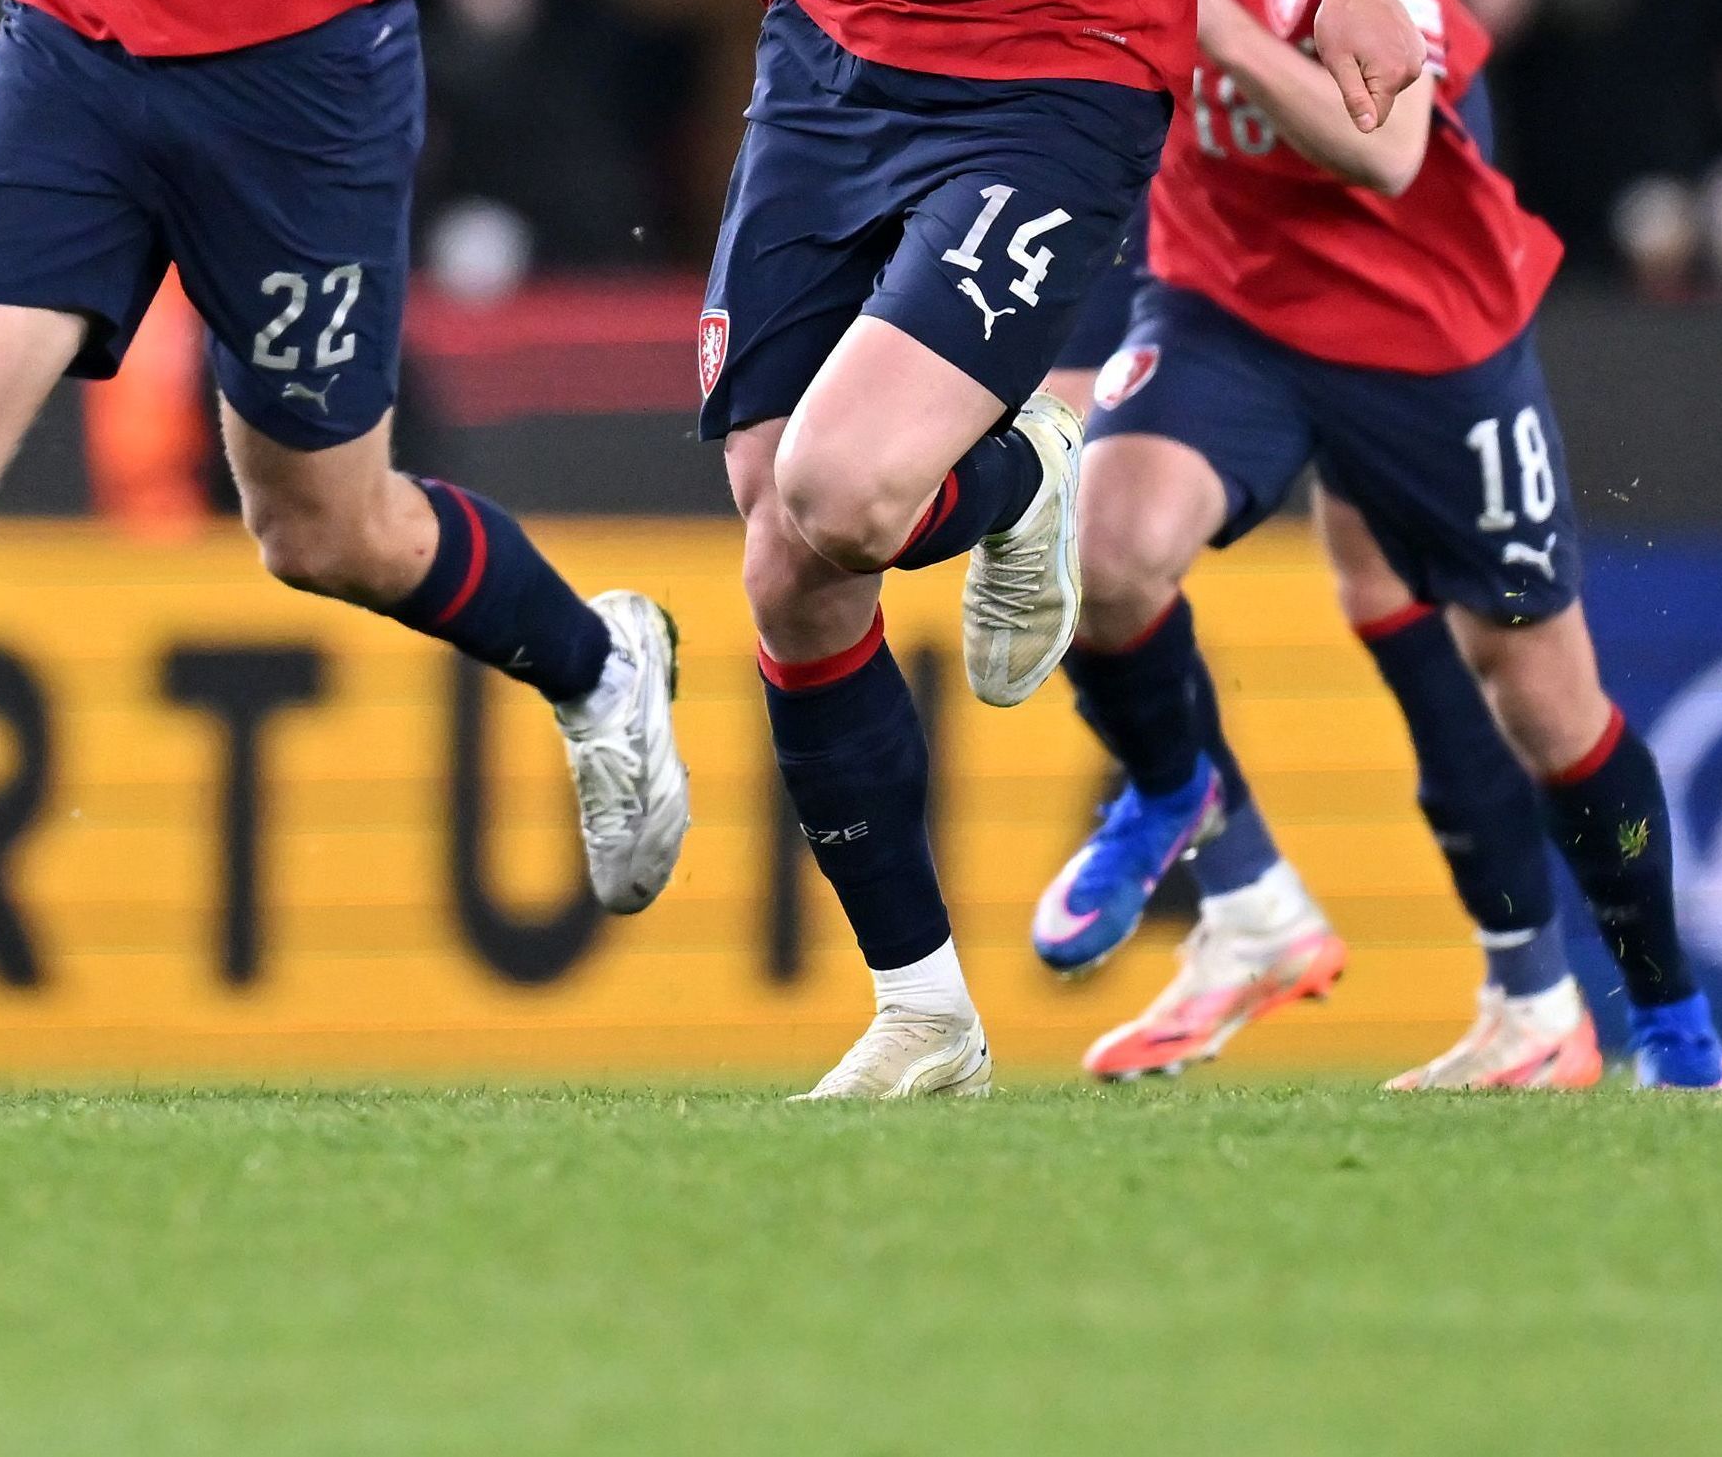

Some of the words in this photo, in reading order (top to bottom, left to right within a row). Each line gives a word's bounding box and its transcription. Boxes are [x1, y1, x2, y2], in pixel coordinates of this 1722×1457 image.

[942, 185, 1072, 306] 14
[252, 263, 362, 370] 22
[1465, 406, 1555, 533] 18
[799, 820, 869, 844] CZE
